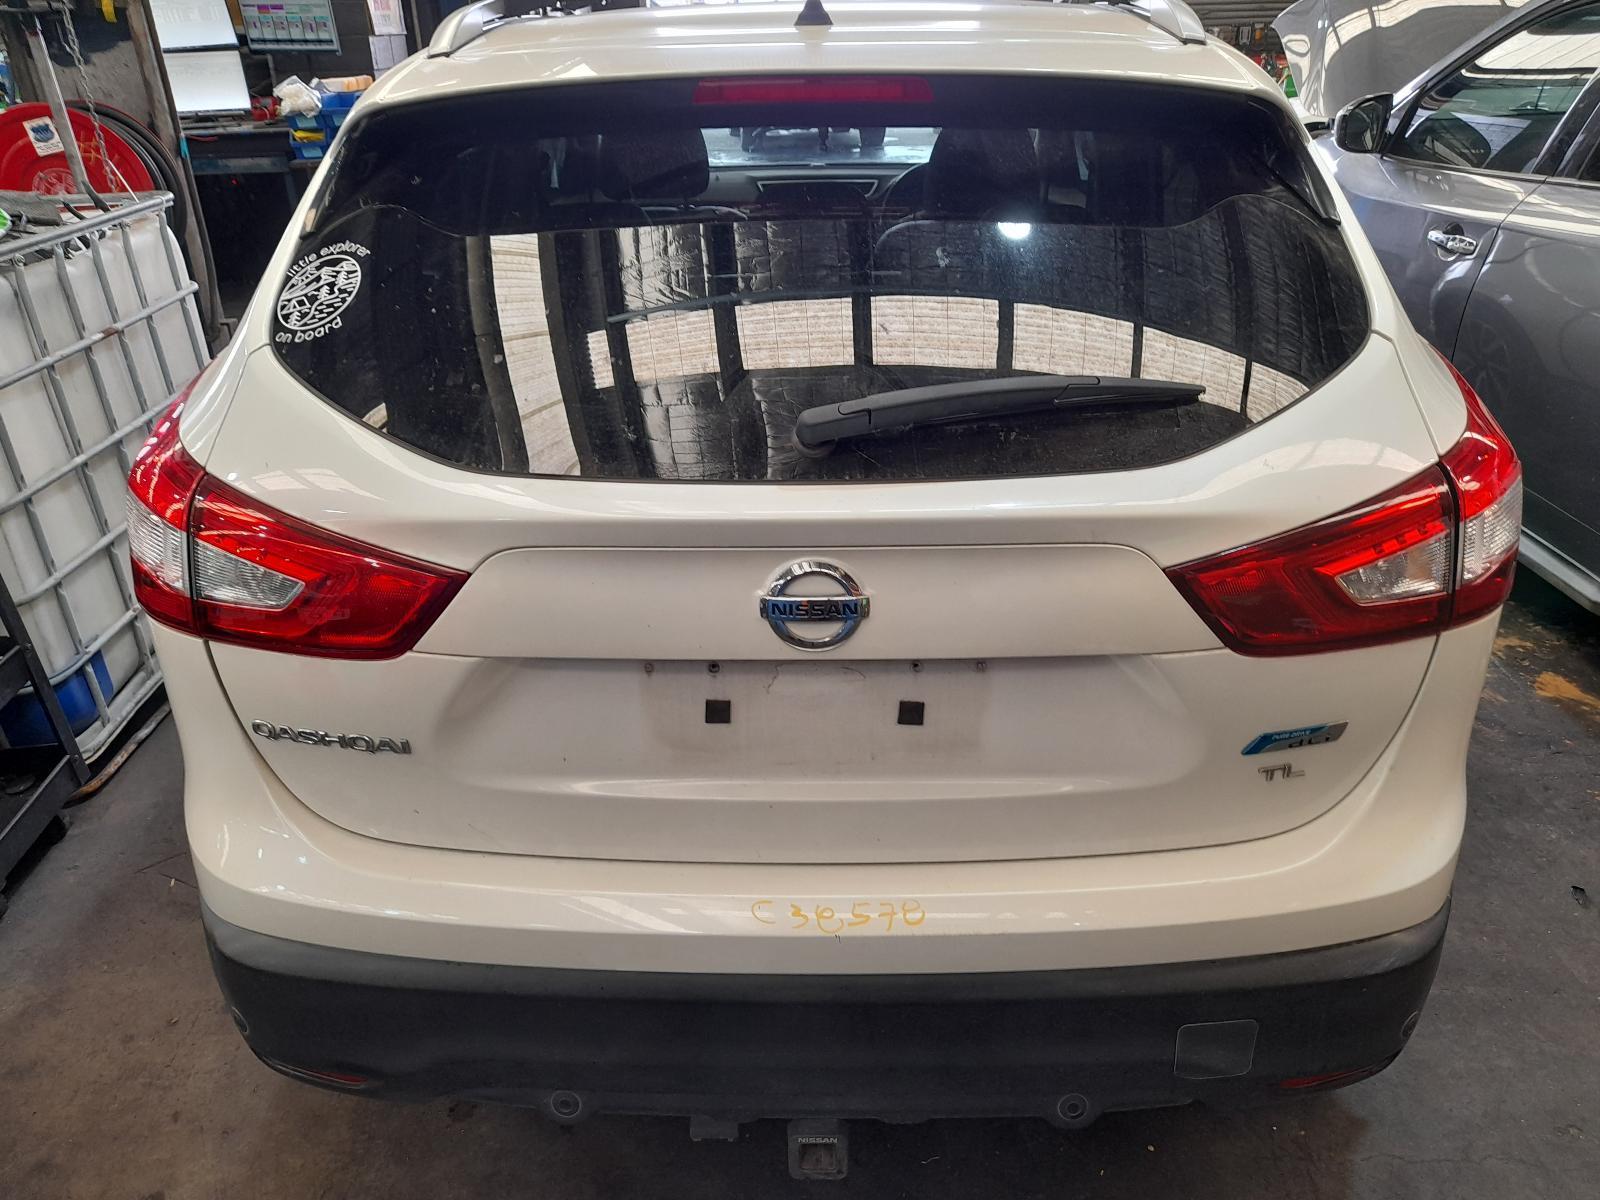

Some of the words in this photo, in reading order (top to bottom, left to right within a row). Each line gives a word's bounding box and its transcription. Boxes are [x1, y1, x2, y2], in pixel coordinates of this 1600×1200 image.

[286, 253, 318, 277] little
[320, 240, 371, 258] explorer
[275, 332, 292, 343] on
[294, 316, 343, 343] board
[771, 602, 858, 618] NISSAN
[251, 719, 412, 755] QASHQAI
[751, 899, 777, 925] C
